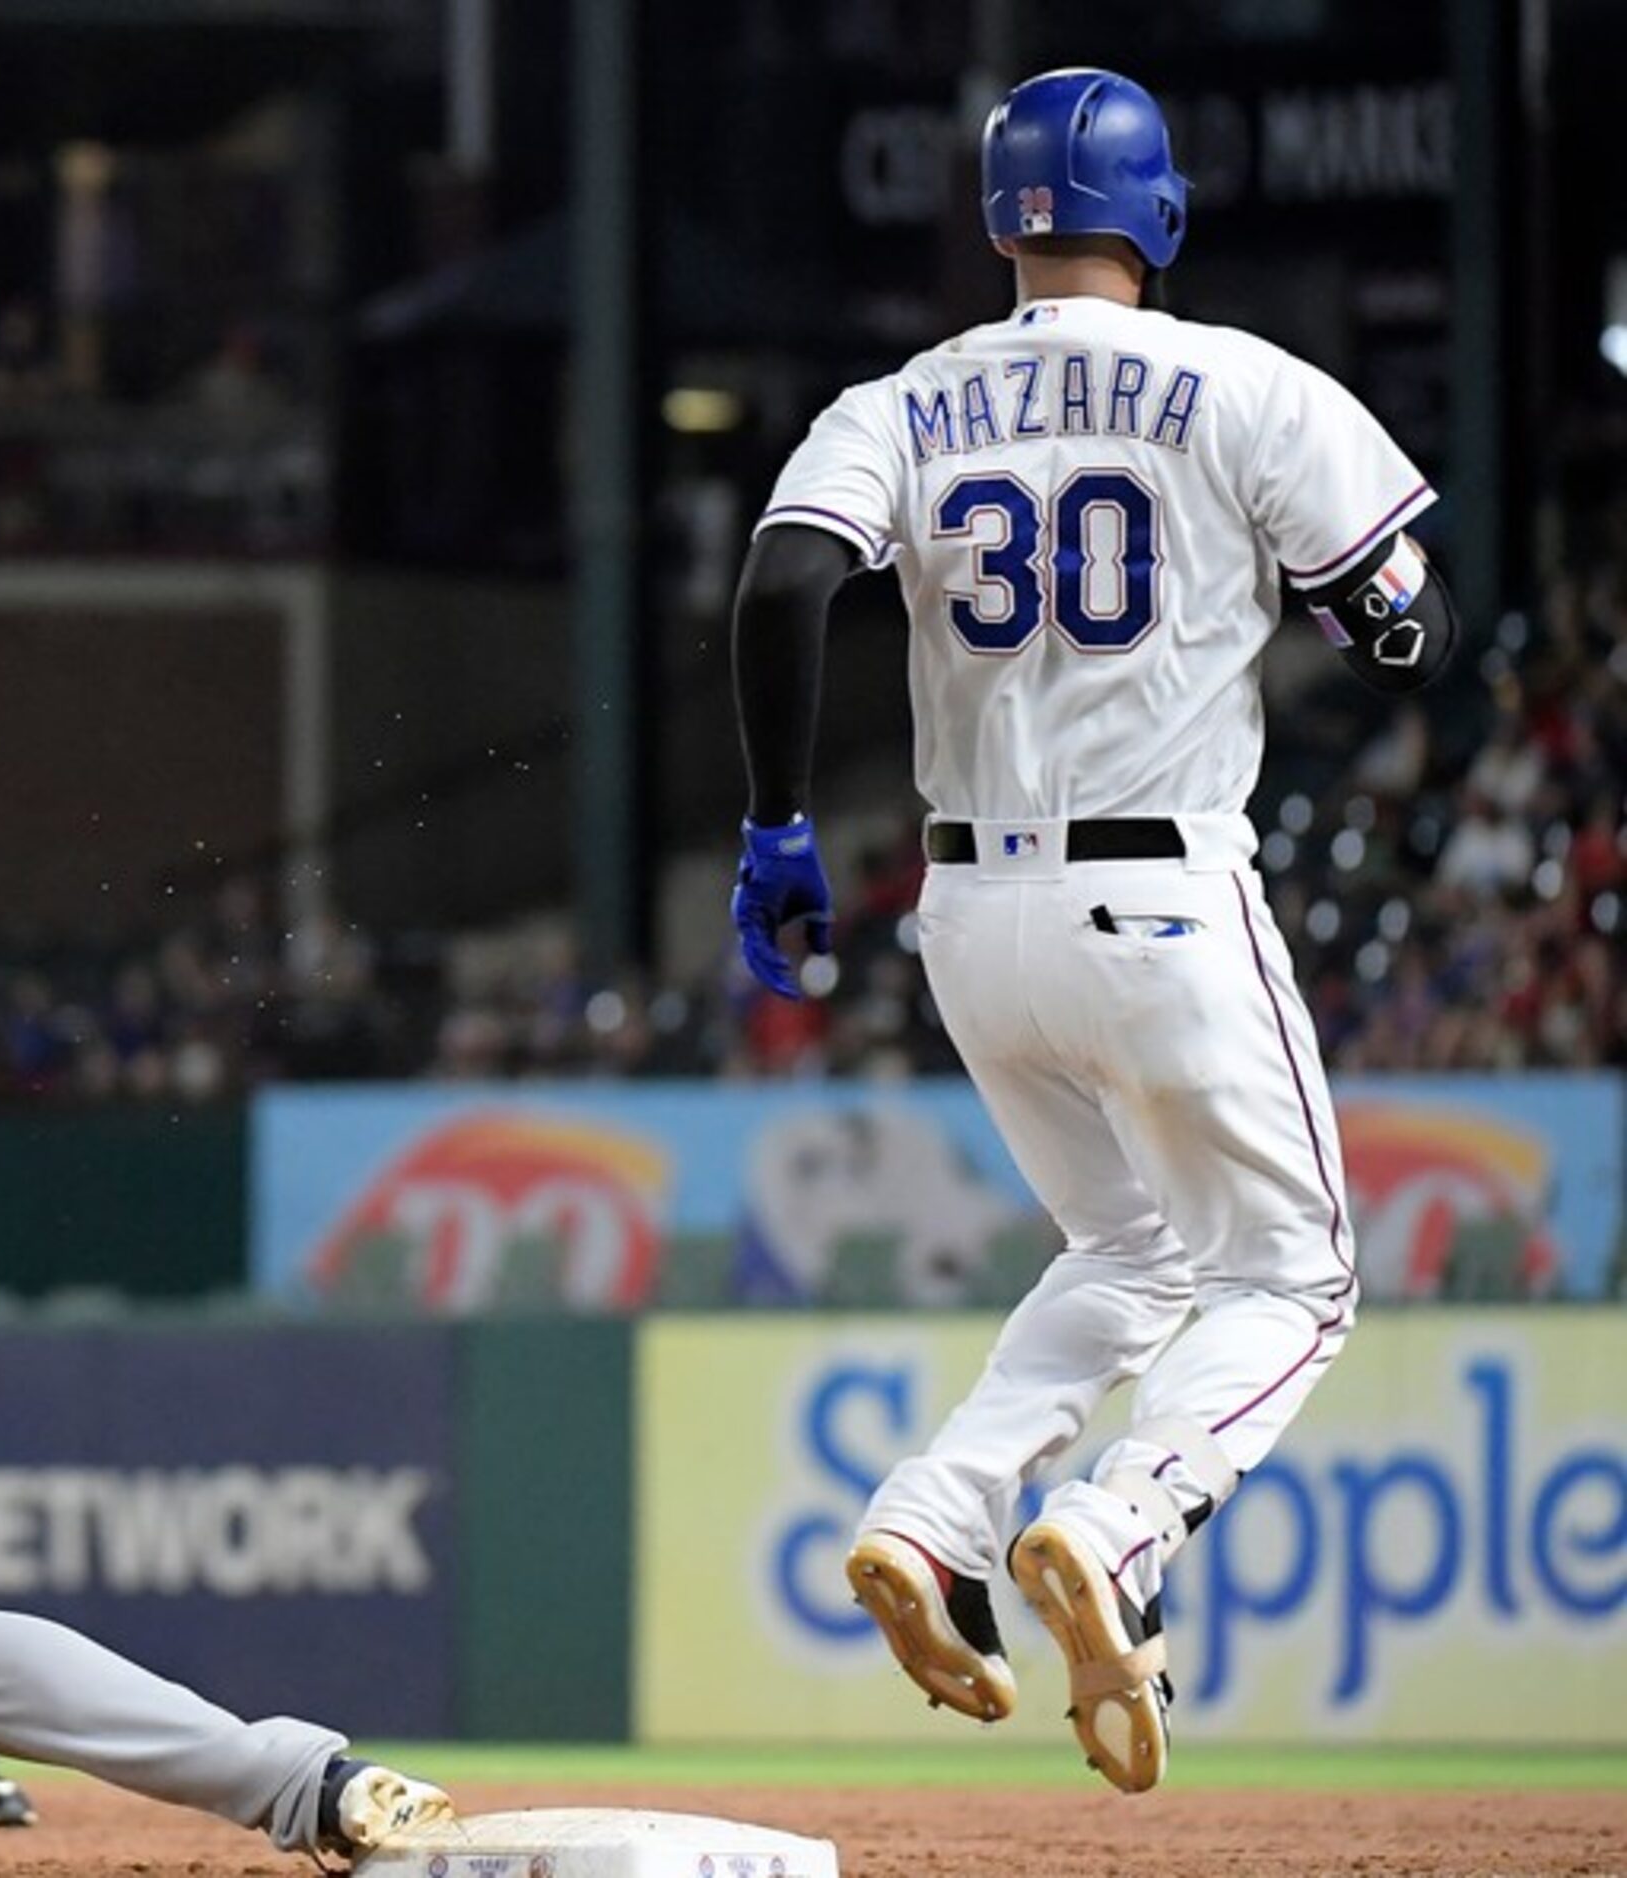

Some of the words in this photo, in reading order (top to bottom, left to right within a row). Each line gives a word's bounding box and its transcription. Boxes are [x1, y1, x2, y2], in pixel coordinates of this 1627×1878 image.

[904, 353, 1202, 466] MAZARA
[931, 466, 1166, 655] 30
[775, 1355, 1627, 1708] Spple
